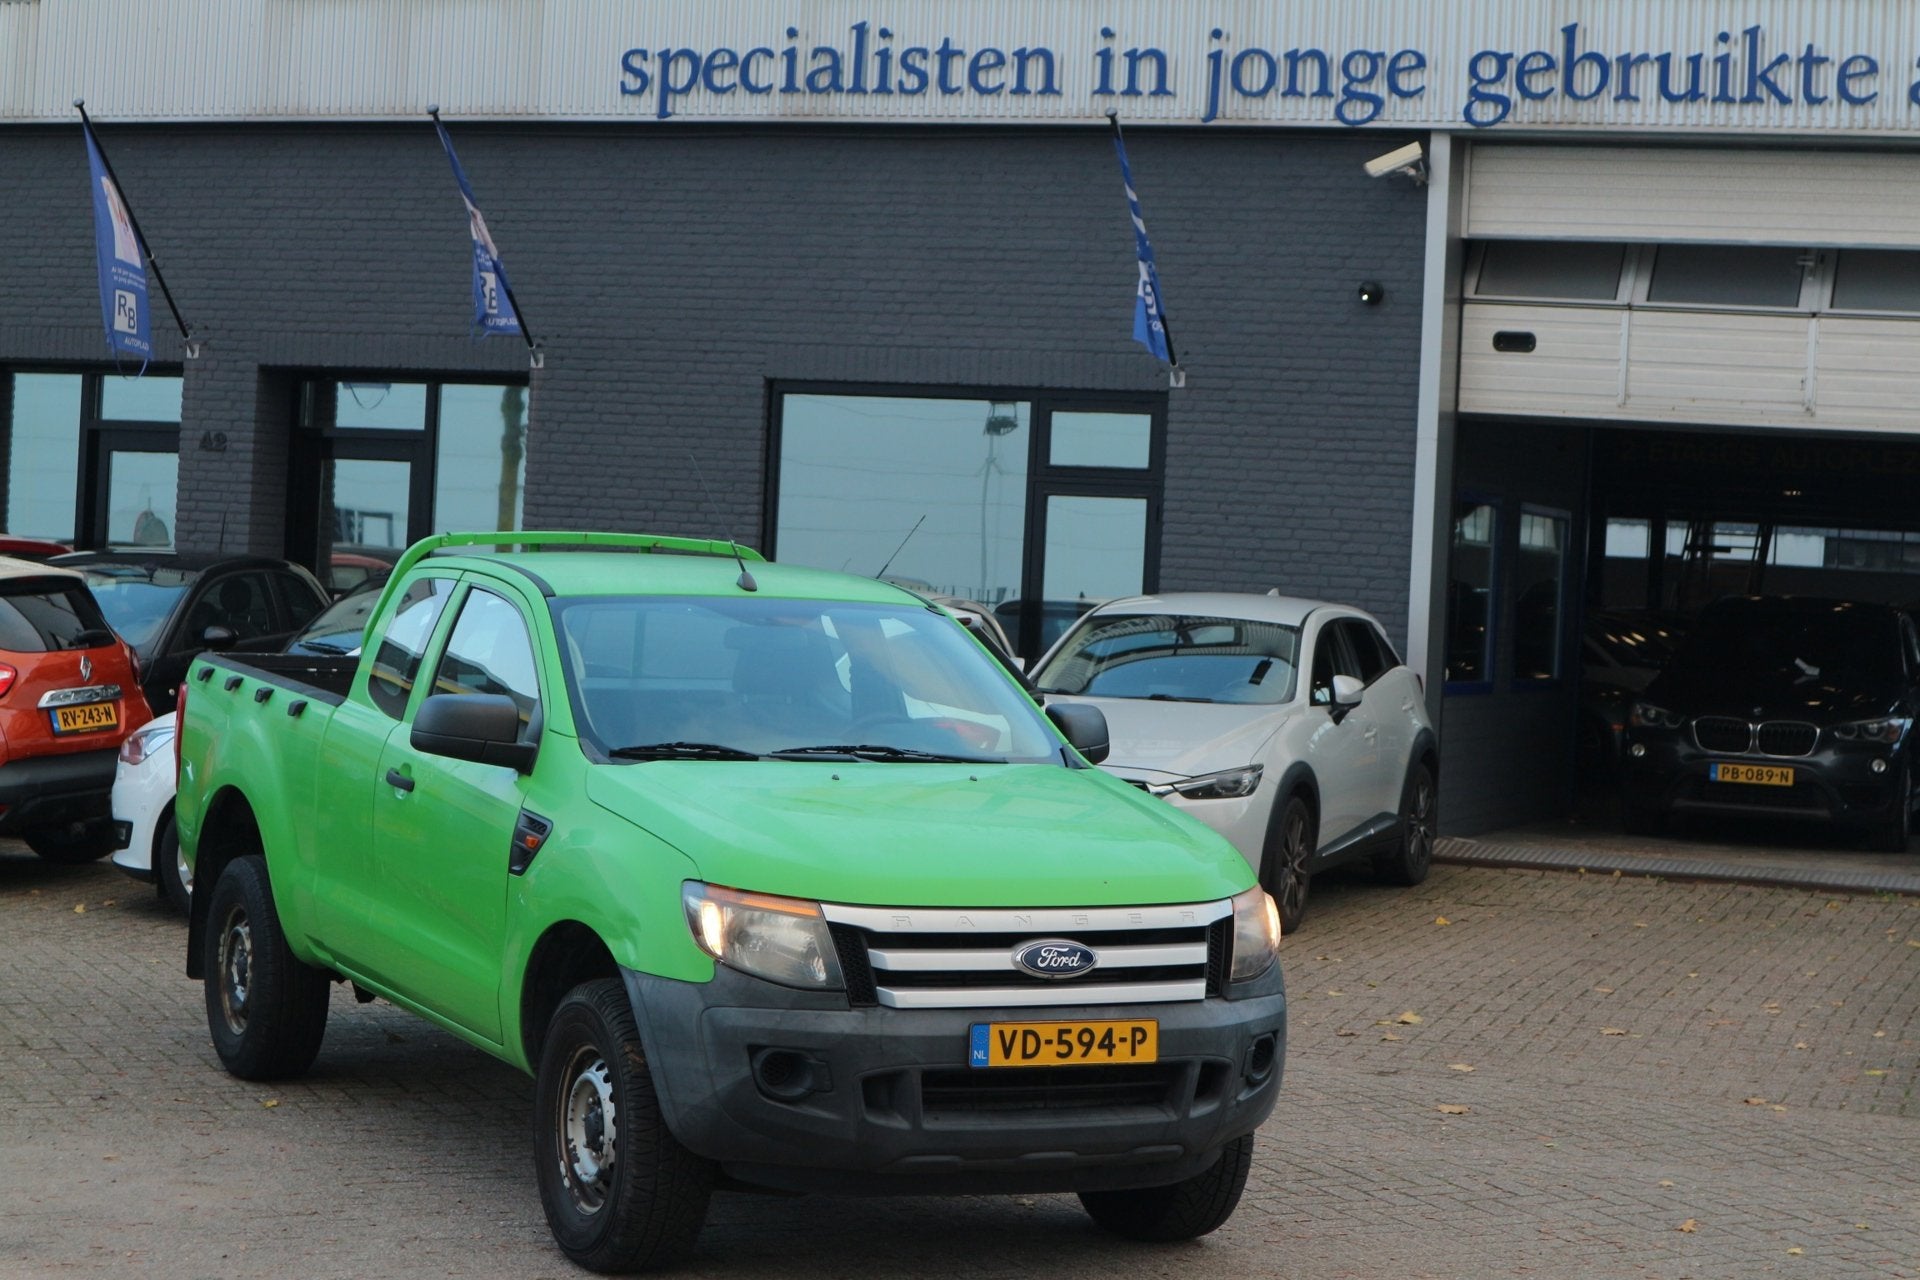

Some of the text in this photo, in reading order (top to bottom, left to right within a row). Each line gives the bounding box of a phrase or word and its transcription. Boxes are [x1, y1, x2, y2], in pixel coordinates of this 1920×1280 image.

[619, 20, 1062, 119] specialisten
[1093, 26, 1175, 98] in
[1200, 27, 1427, 126] jonge
[1462, 22, 1879, 127] gebruikte
[61, 706, 113, 727] RV-243-N
[1721, 765, 1790, 783] PB-089-N
[891, 910, 1195, 929] RANGER
[1037, 946, 1081, 968] Ford
[973, 1026, 1149, 1060] NL VD-594-P
